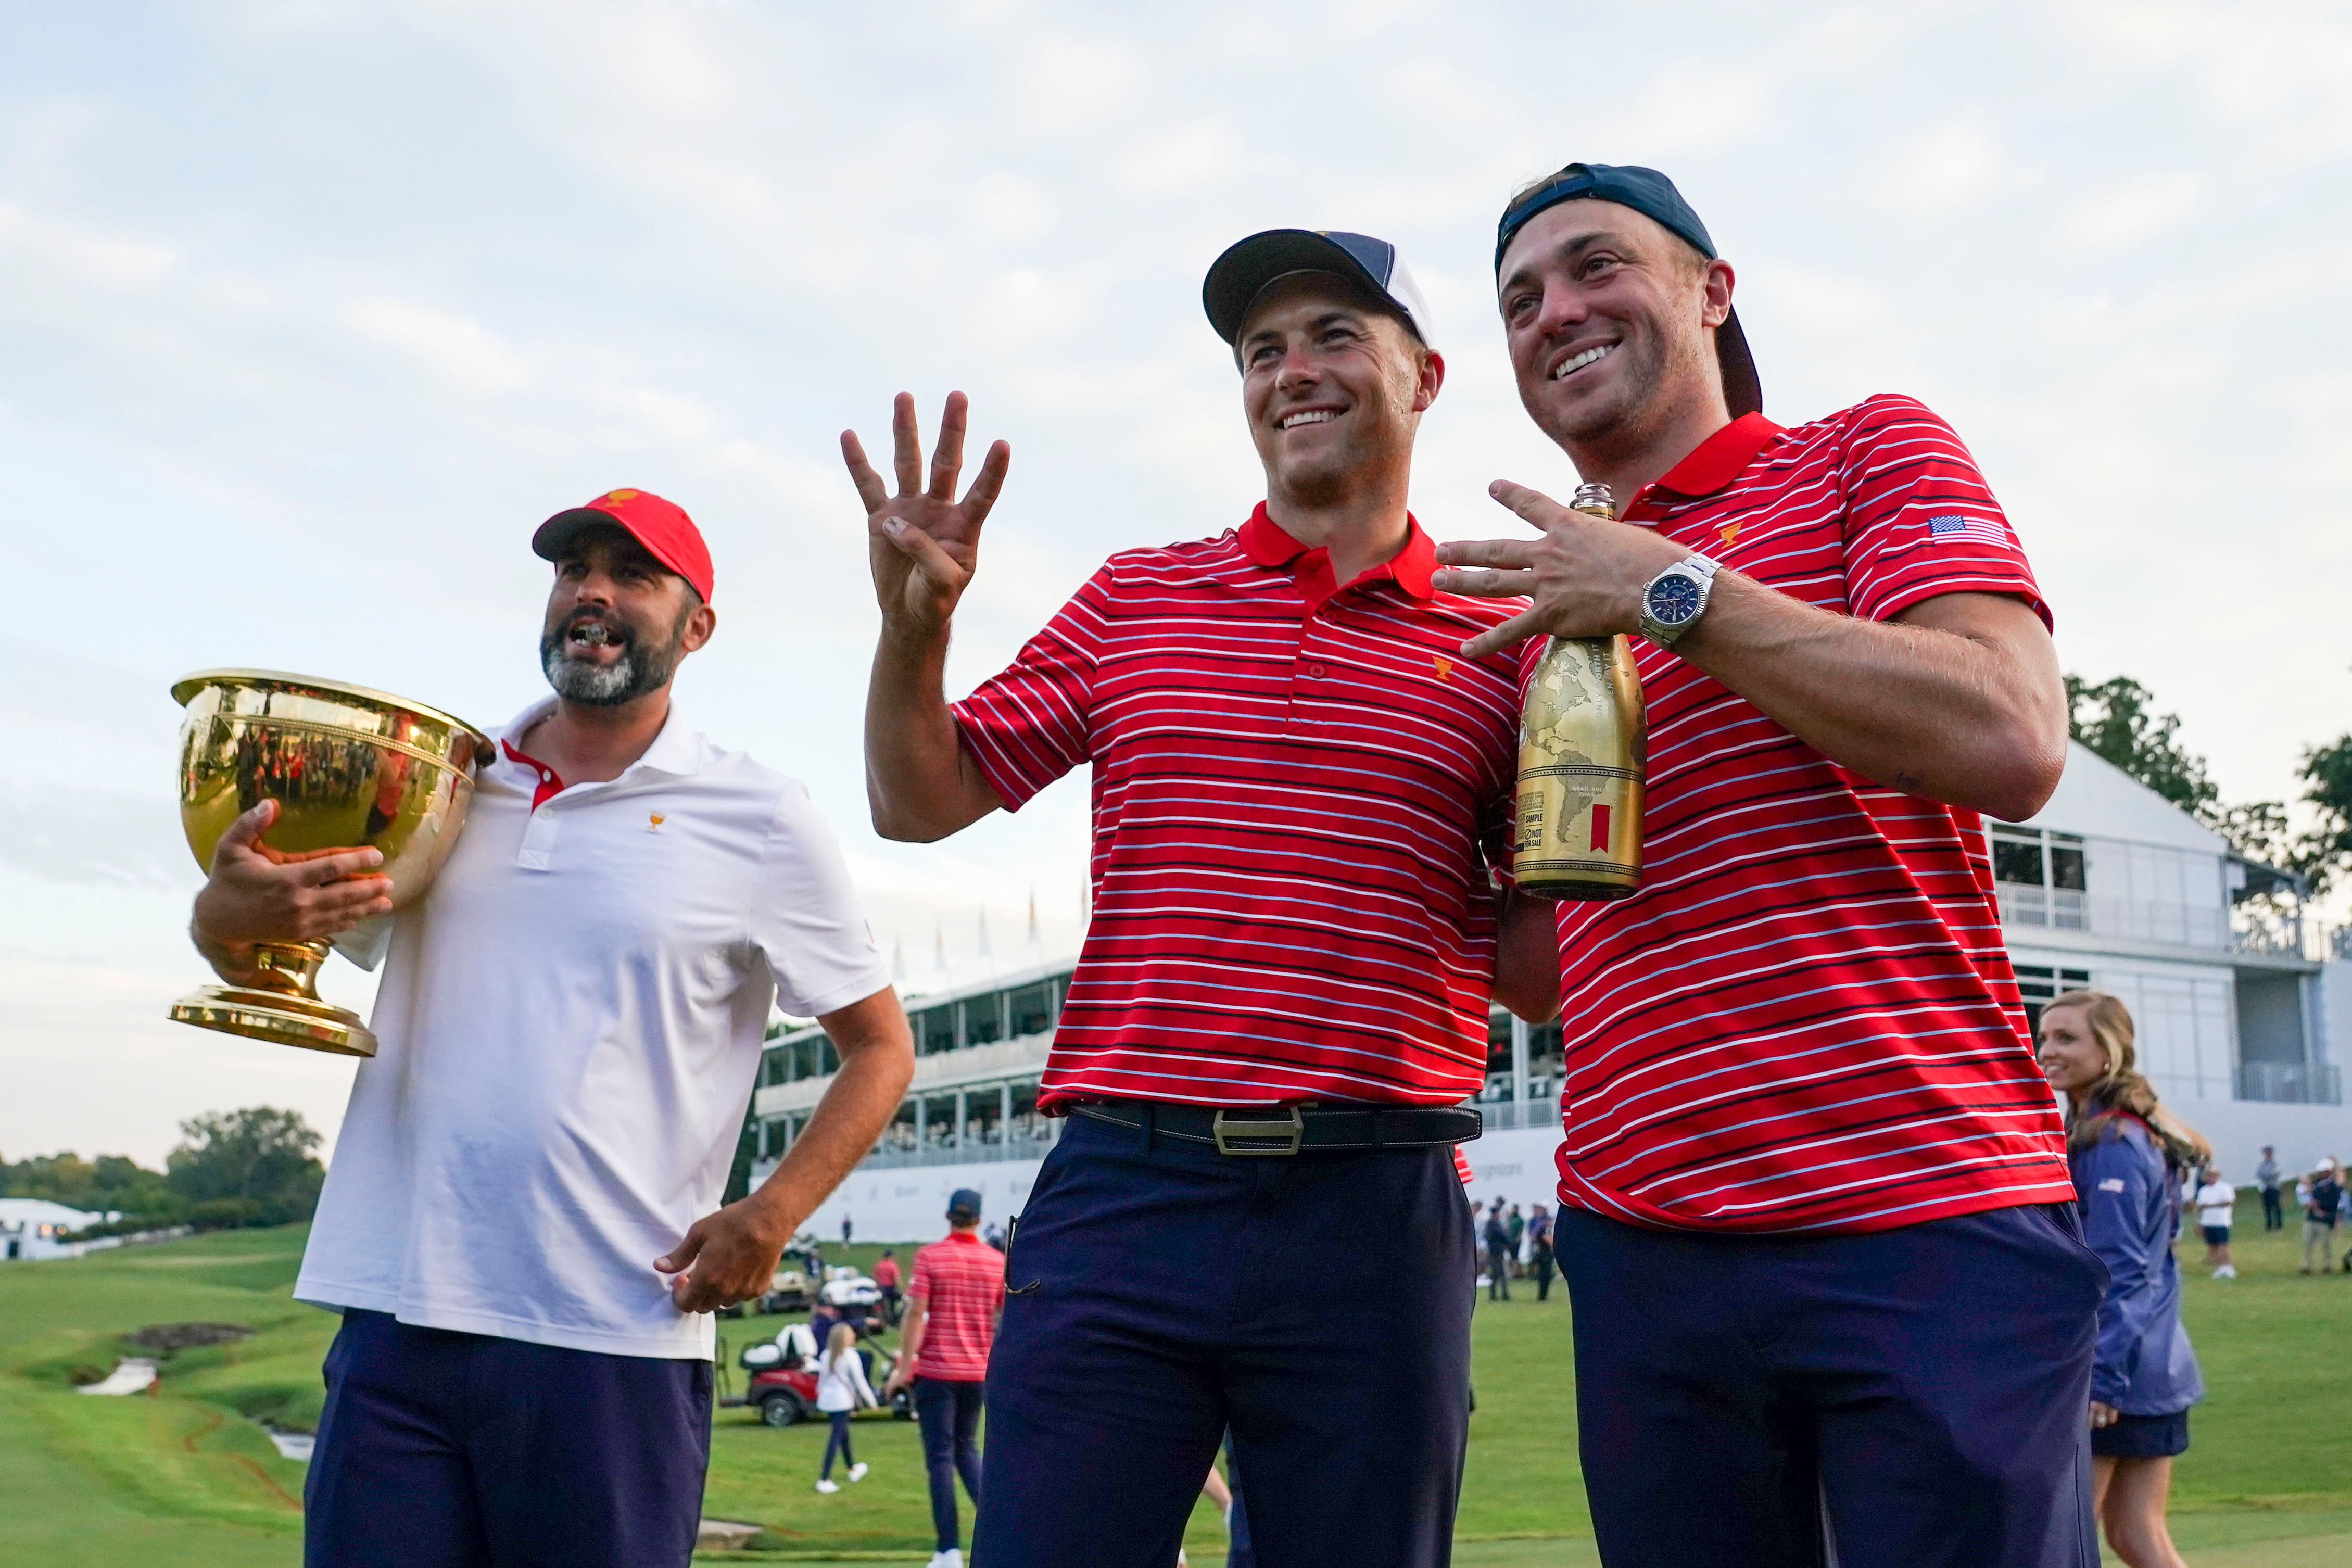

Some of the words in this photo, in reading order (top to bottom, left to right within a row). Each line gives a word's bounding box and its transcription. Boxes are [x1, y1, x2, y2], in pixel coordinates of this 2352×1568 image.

[1591, 643, 1599, 651] IT
[1602, 652, 1611, 661] IT
[1594, 654, 1603, 688] WORTH
[1525, 813, 1543, 823] SAMPLE
[1531, 829, 1542, 838] NOT
